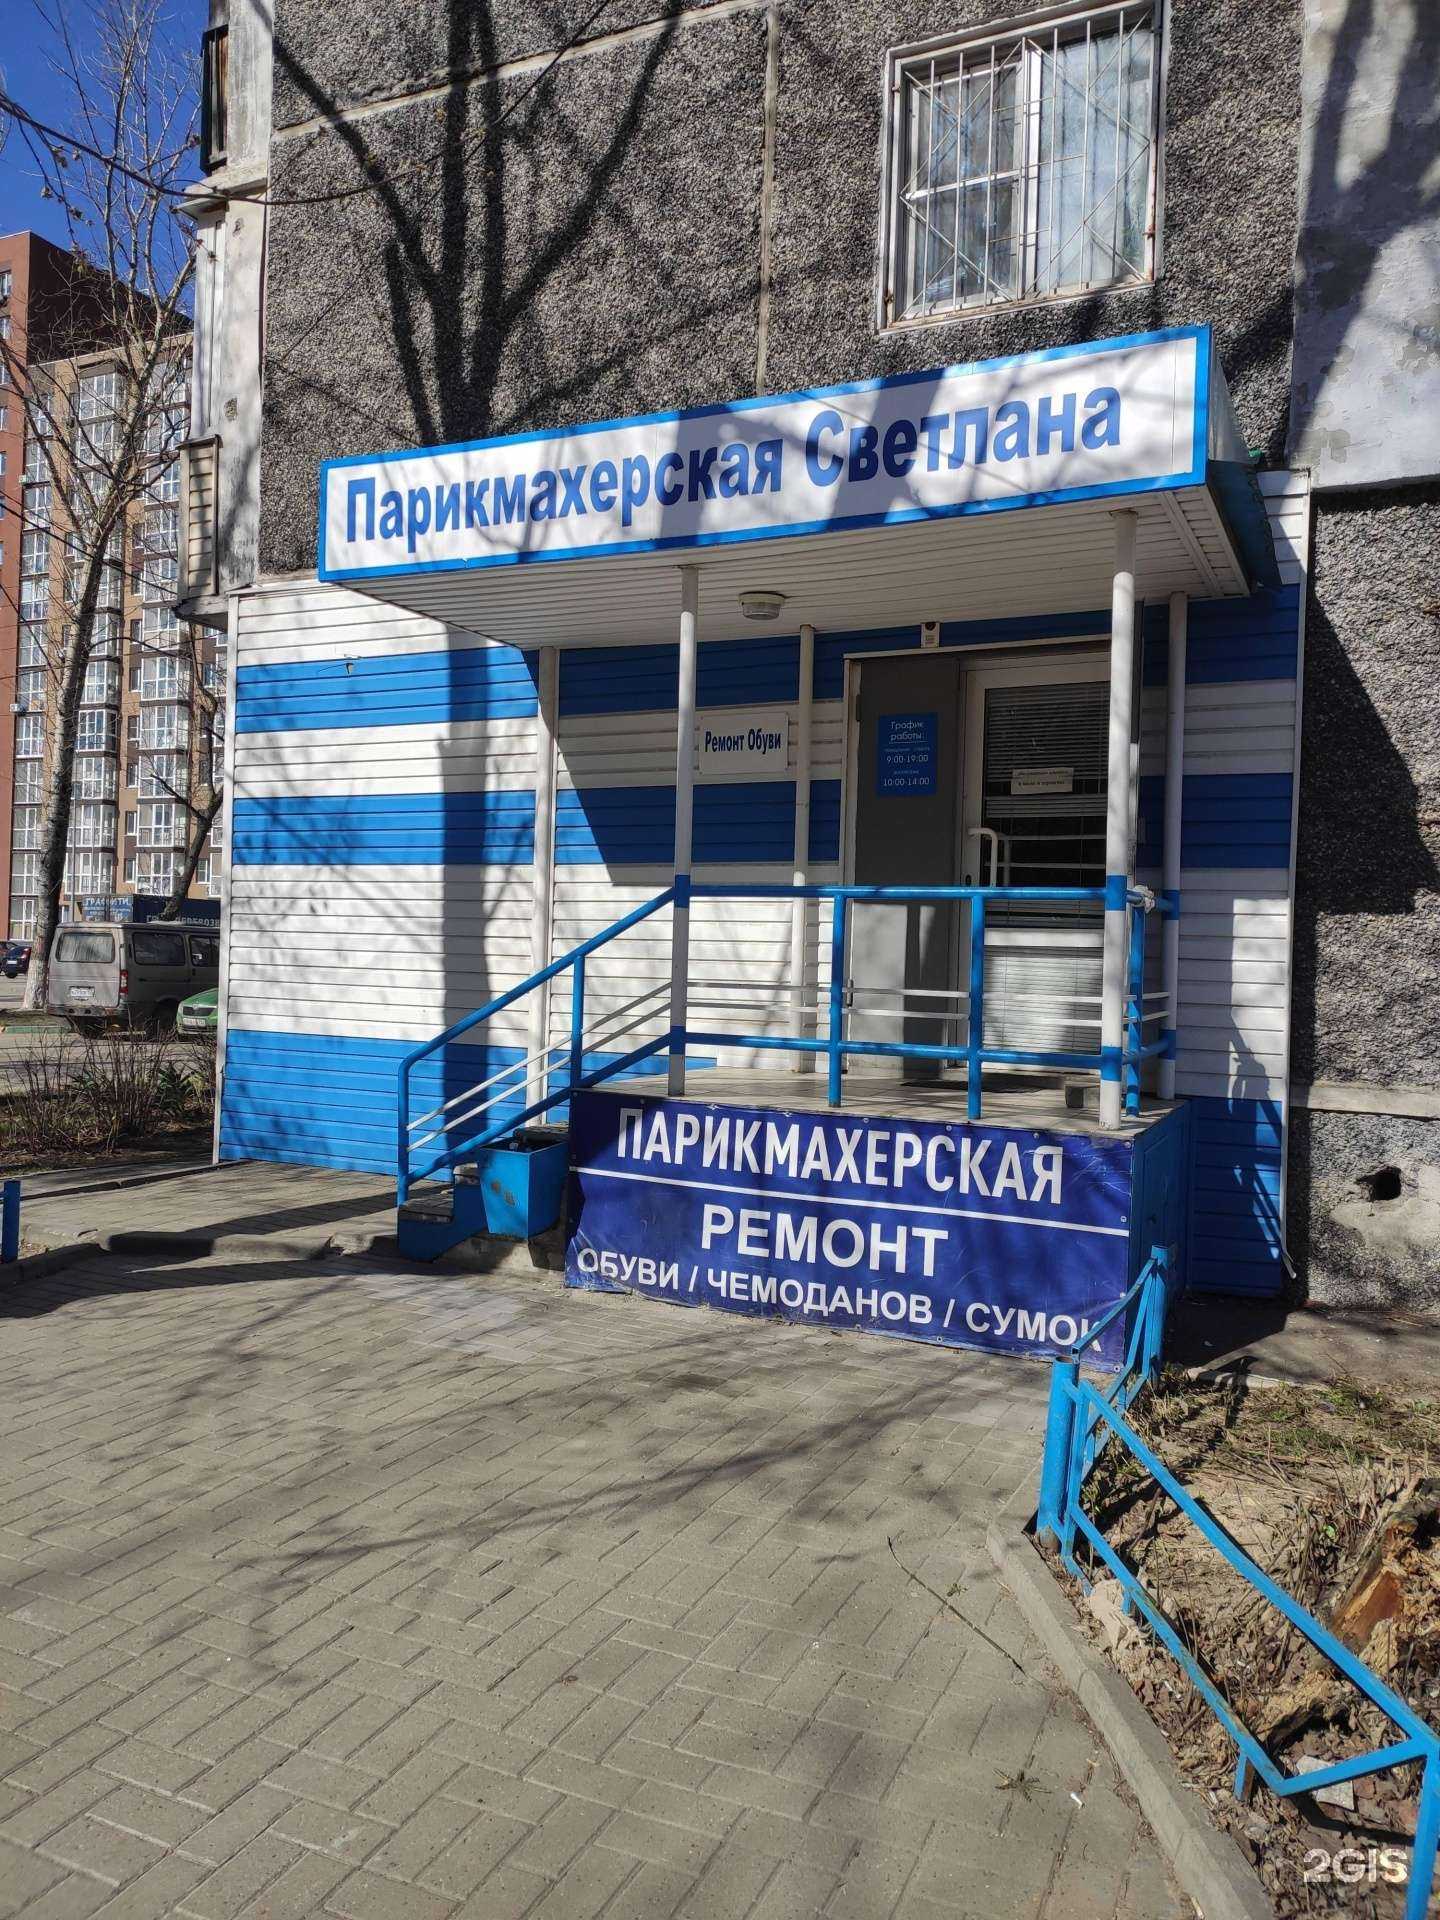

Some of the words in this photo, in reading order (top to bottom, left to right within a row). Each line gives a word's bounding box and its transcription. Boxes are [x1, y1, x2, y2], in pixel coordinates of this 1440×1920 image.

[345, 438, 785, 554] Парикмахерская
[806, 387, 1121, 487] Светлана
[704, 730, 745, 753] Ремонт
[747, 728, 782, 755] Обуви
[617, 1107, 1064, 1205] ПАРИКМАХЕРСКАЯ
[701, 1203, 949, 1277] РЕМОНТ
[577, 1248, 679, 1291] ОБУВИ
[688, 1265, 699, 1293] /
[707, 1267, 933, 1325] ЧЕМОДАНОВ
[943, 1299, 956, 1328] /
